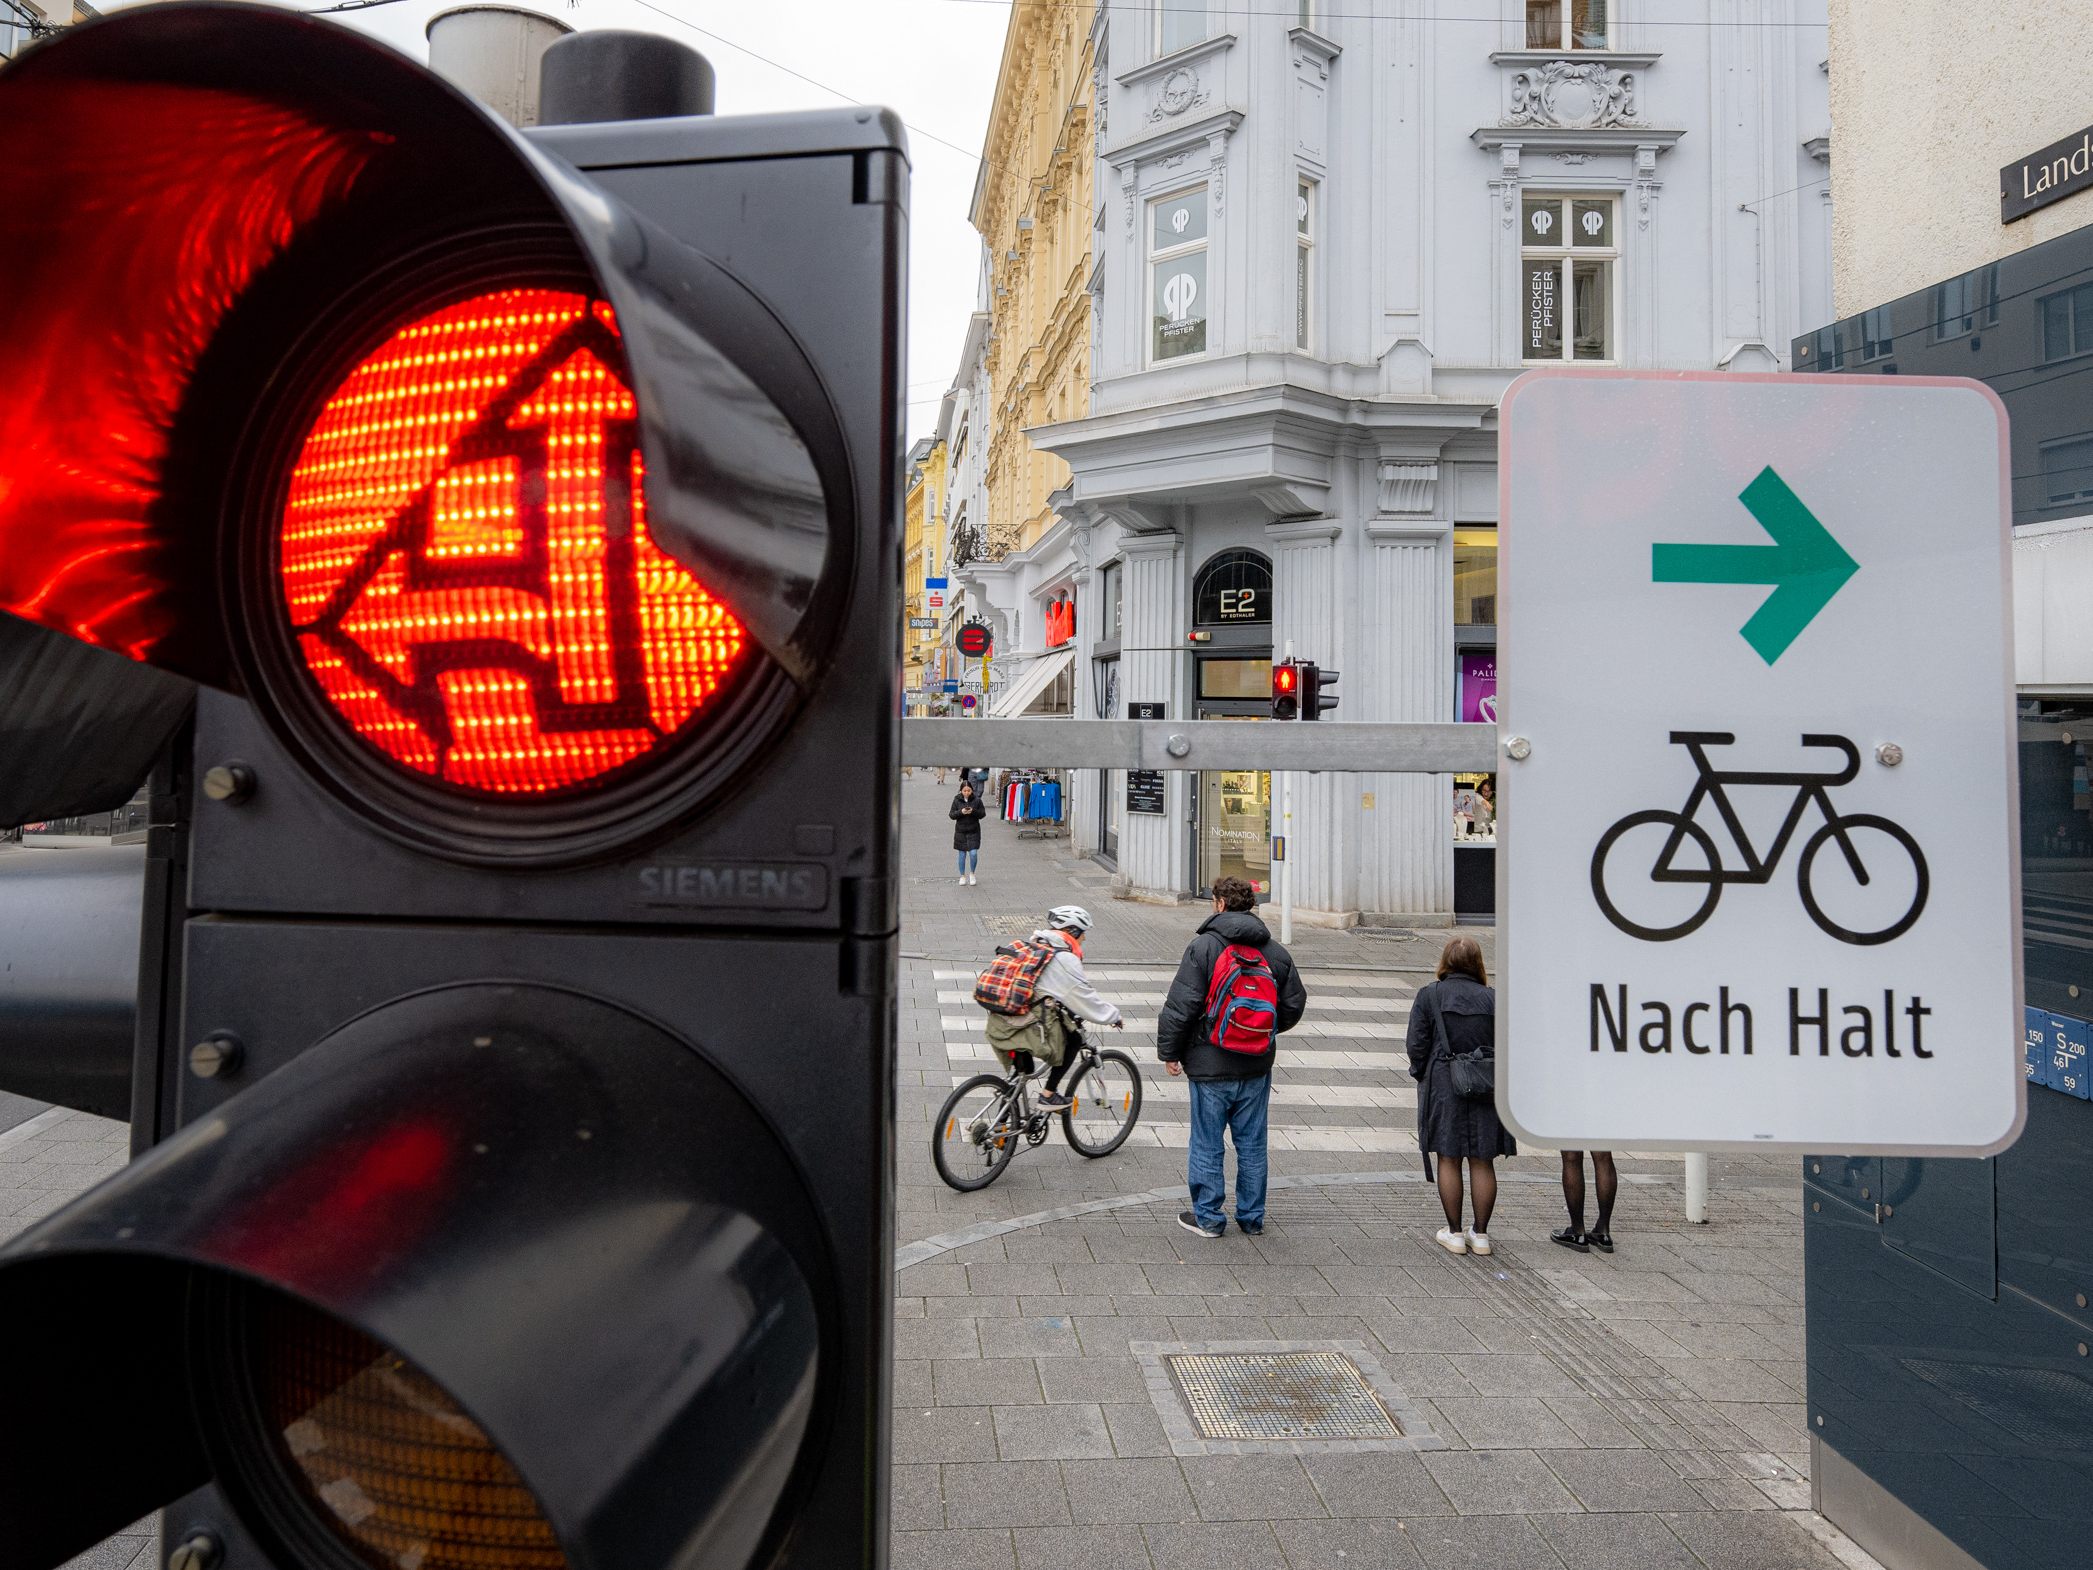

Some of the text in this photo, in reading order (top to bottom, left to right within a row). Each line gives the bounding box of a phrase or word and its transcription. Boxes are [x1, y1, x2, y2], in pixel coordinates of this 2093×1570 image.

[2023, 134, 2093, 199] Land
[1531, 271, 1541, 347] PERÜCKEN
[1543, 271, 1553, 327] PFISTER
[1164, 325, 1195, 338] PFISTER
[1220, 588, 1255, 613] E2
[1141, 709, 1152, 718] E2
[639, 866, 813, 898] SIEMENS
[1589, 983, 1935, 1059] Nach Halt
[2057, 1033, 2085, 1055] S 200
[2064, 1076, 2075, 1088] 59
